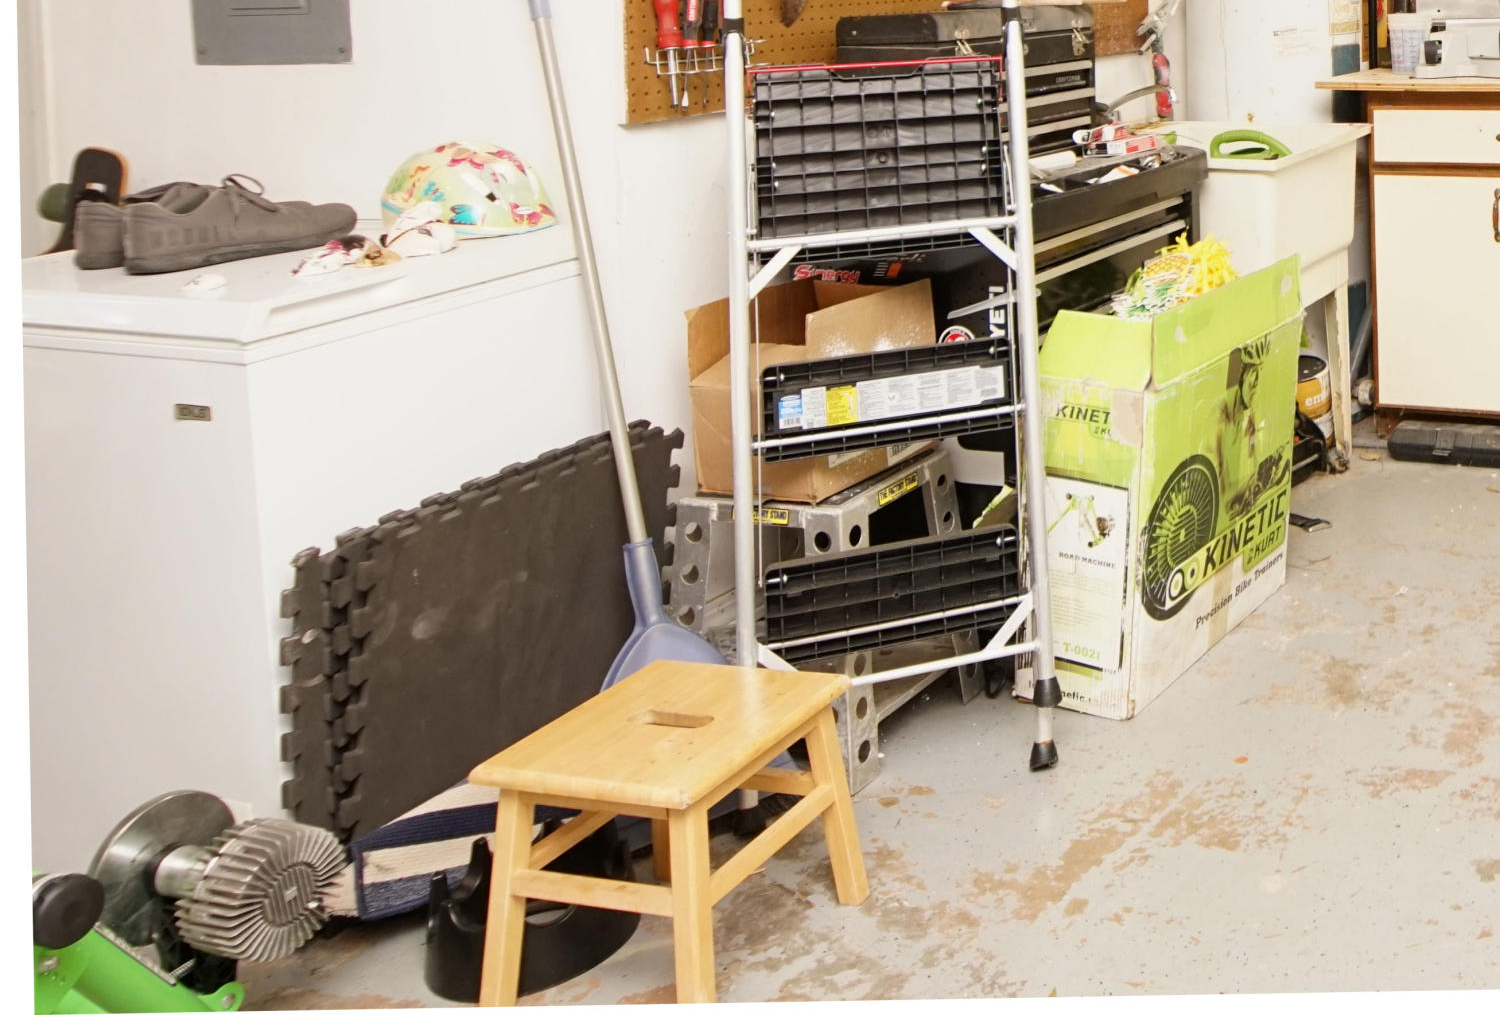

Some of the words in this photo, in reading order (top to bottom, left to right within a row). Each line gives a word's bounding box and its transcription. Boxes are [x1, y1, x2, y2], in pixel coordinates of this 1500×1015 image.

[1055, 74, 1081, 83] CRAFTSMAN
[1056, 404, 1111, 425] KINET
[769, 510, 787, 520] STAND
[1203, 490, 1287, 579] KINETIC
[1253, 525, 1282, 557] KURT
[1080, 556, 1117, 569] MACHINE
[1194, 593, 1233, 631] Precision
[1234, 576, 1252, 598] Bike
[1254, 552, 1283, 580] Trainers
